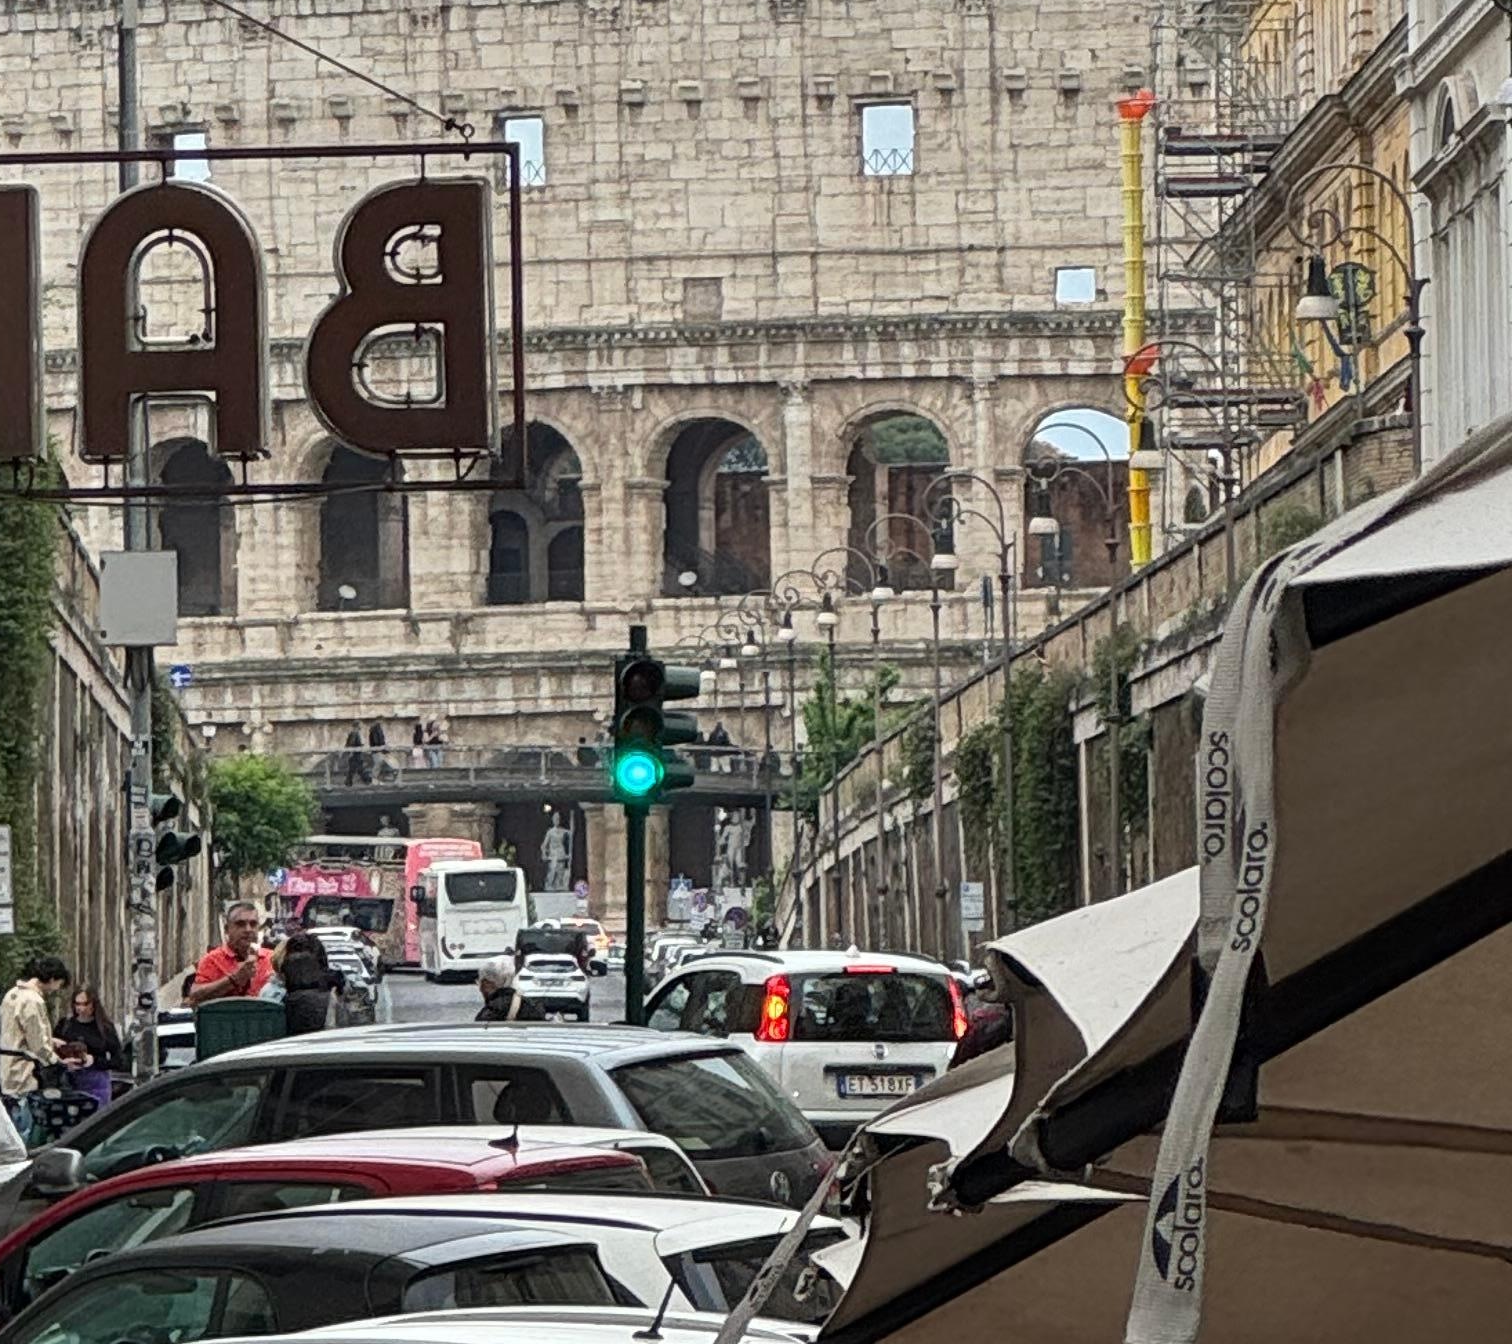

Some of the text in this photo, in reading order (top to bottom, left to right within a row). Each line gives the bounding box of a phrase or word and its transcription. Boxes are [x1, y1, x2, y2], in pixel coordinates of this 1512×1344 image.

[1205, 729, 1229, 866] scolaro.
[1230, 820, 1270, 953] scolaro.
[1172, 1155, 1206, 1293] scolaro.
